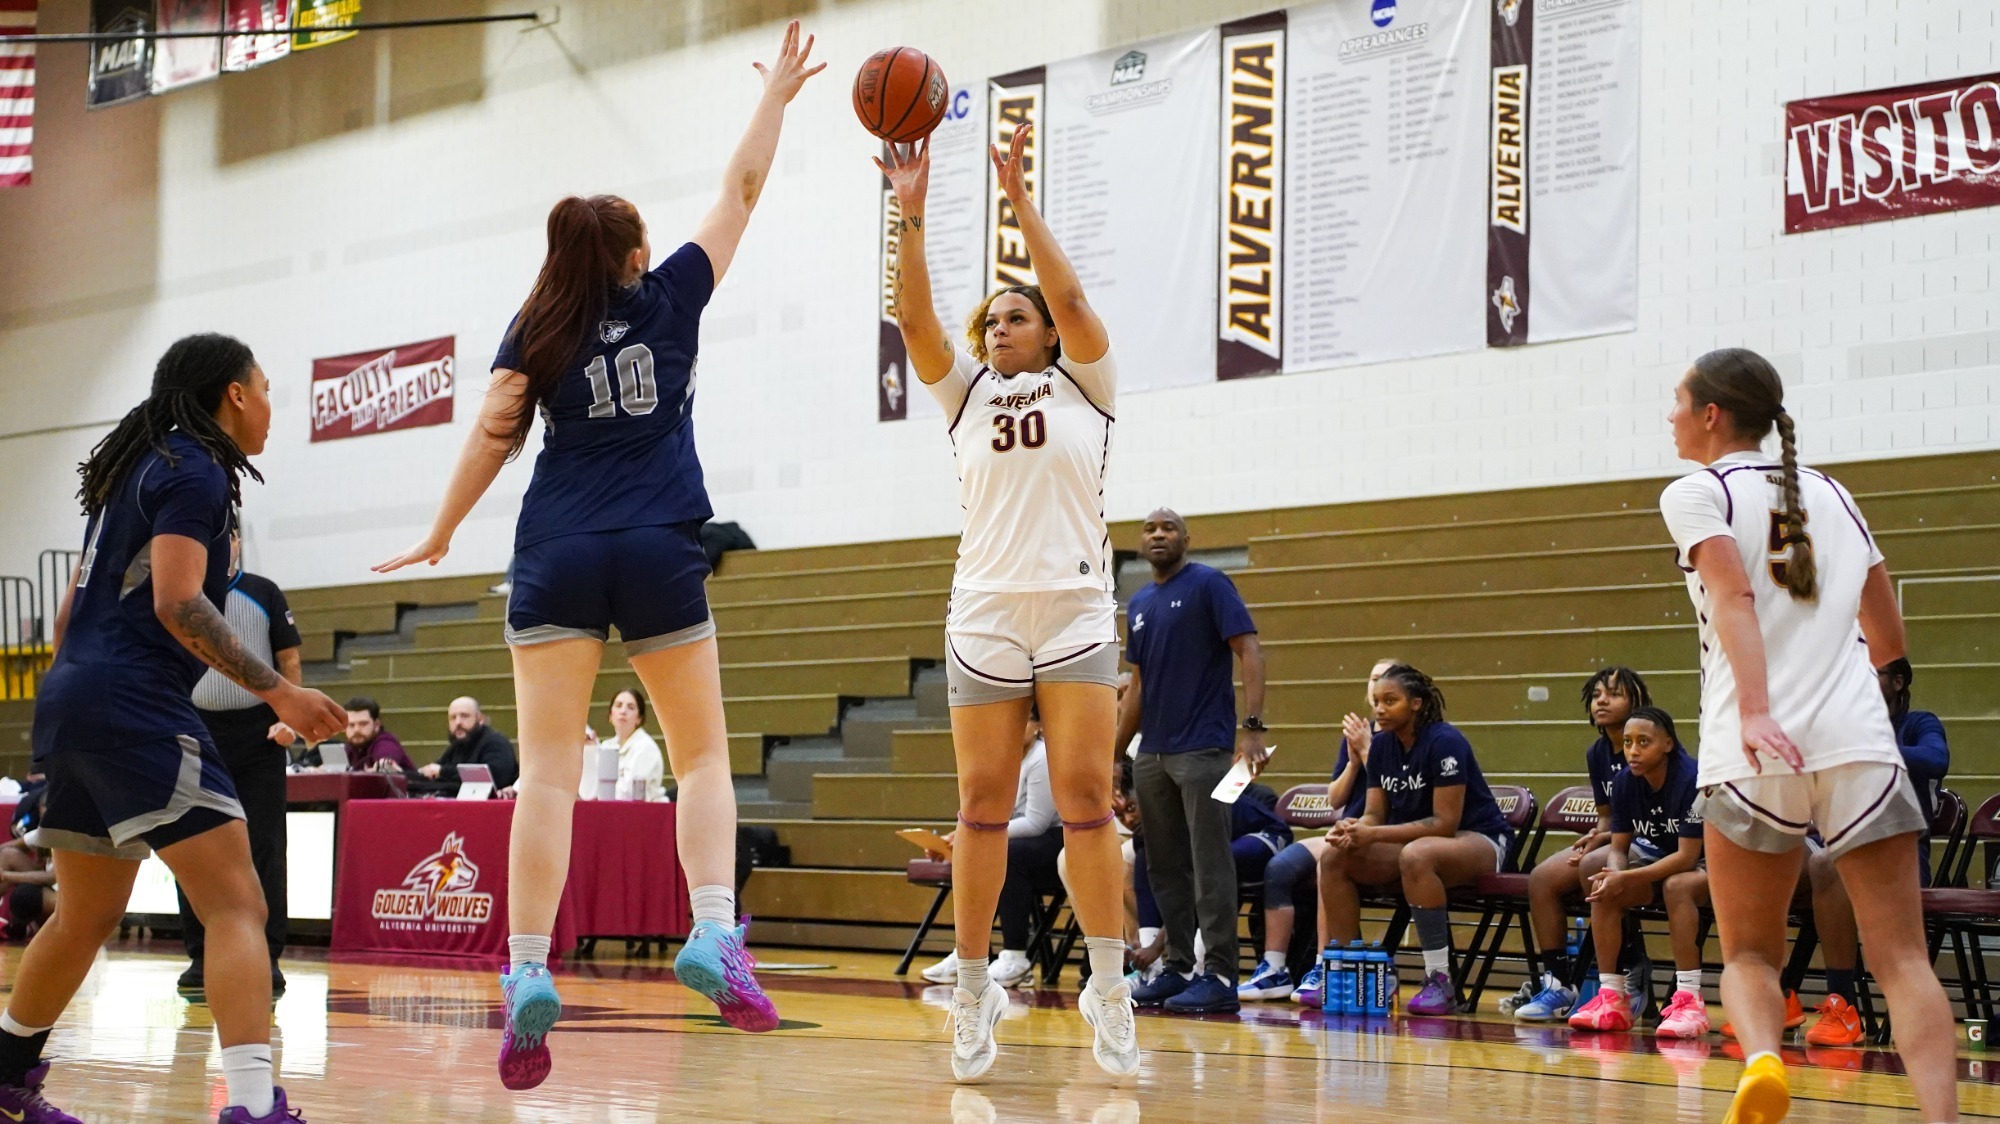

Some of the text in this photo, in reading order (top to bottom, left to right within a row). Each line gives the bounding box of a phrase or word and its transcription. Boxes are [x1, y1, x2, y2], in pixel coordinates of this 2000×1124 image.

[1339, 23, 1427, 54] APPEARANCES
[1085, 79, 1172, 109] CHAMPIONSHIPS
[1112, 64, 1143, 83] MAC
[1497, 70, 1521, 225] ALVERNIA
[1790, 81, 2000, 213] VISITO
[1228, 42, 1274, 344] ALVERNIA
[313, 352, 396, 425] FACULTY
[377, 356, 453, 427] FRIENDS
[584, 343, 658, 418] 10
[352, 403, 374, 429] AND
[991, 409, 1048, 453] 30
[1768, 508, 1816, 604] 5
[375, 893, 490, 919] GOLDEN WOLVES
[379, 920, 477, 934] ALVERNIA UNIVERSITY
[1377, 962, 1385, 1007] POWERADE
